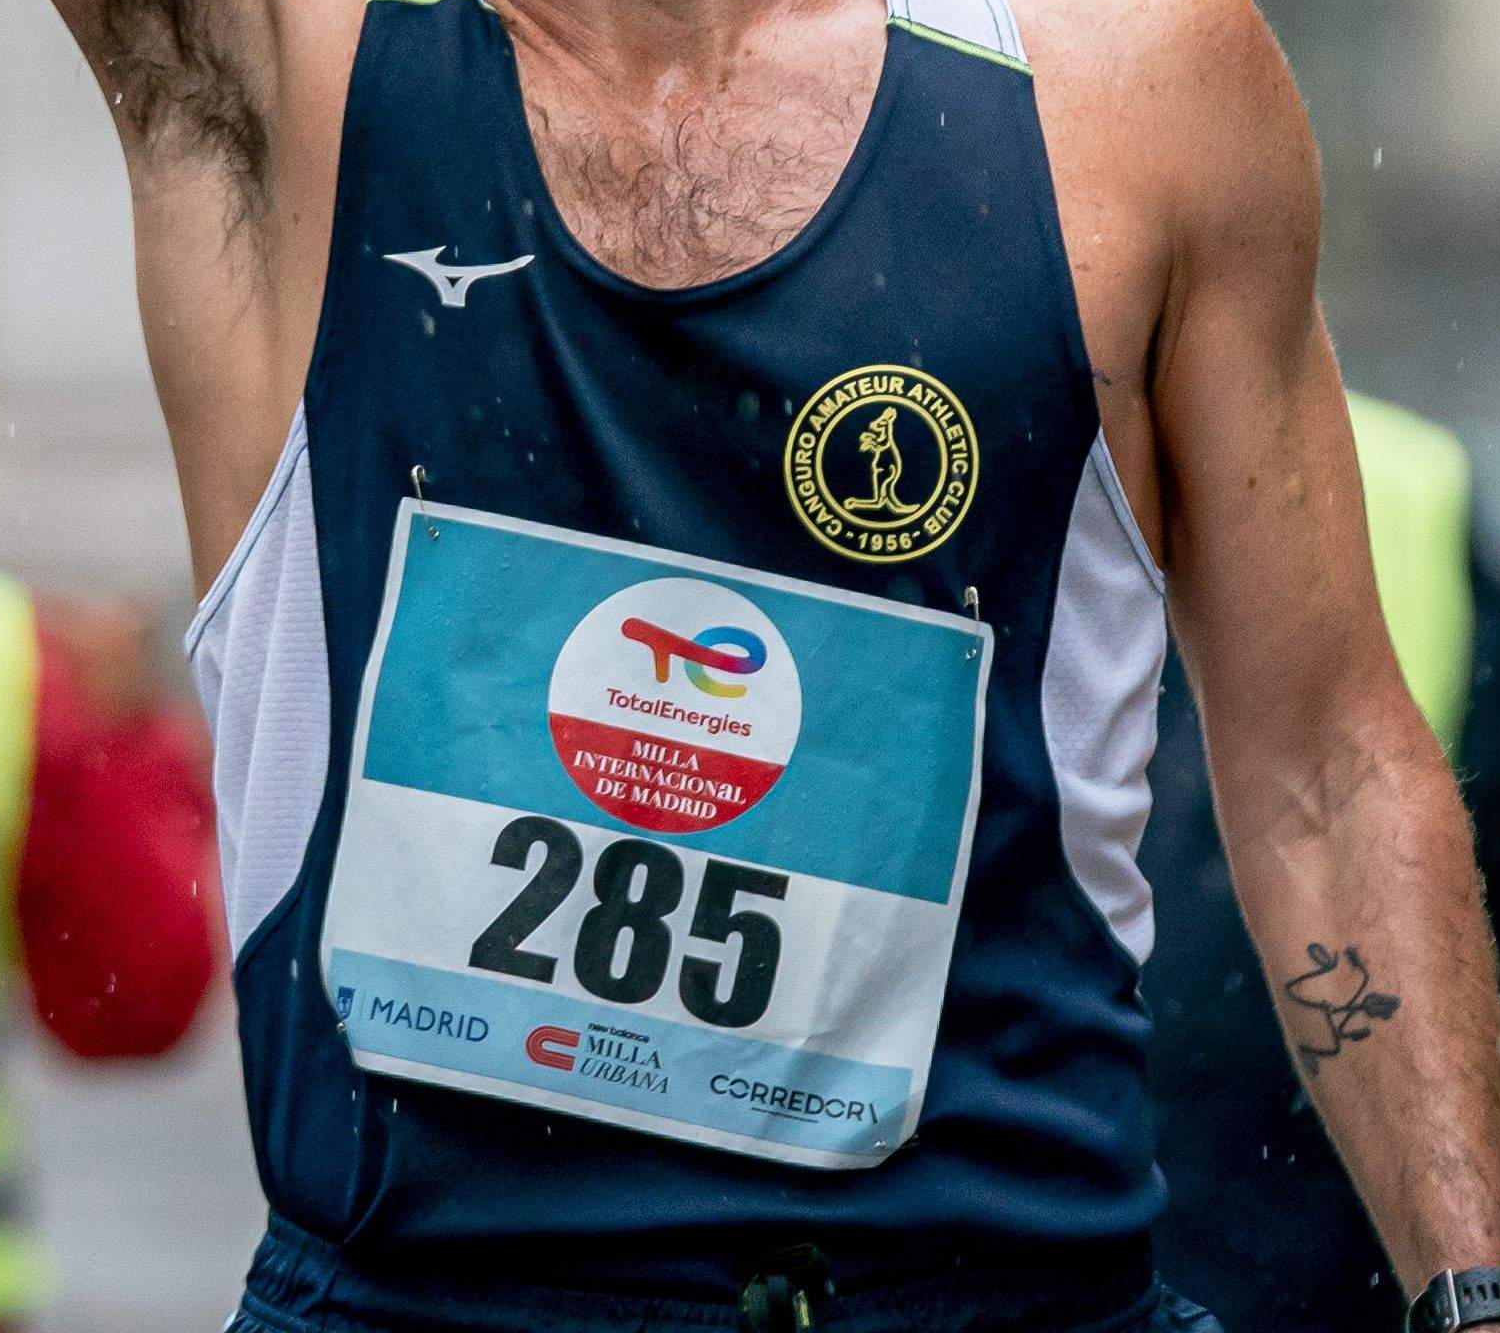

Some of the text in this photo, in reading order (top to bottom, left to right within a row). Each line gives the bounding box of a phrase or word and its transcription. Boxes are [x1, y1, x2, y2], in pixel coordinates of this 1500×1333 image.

[795, 375, 969, 537] CANGURO AMATEUR ATHLETIC CLUB
[606, 688, 752, 737] TotalEnergies
[632, 740, 699, 771] MILLA
[594, 777, 718, 820] DE MADRID
[468, 815, 789, 1028] 285
[369, 996, 489, 1043] MADRID
[588, 1034, 662, 1069] MILLA
[579, 1058, 669, 1094] URBANA
